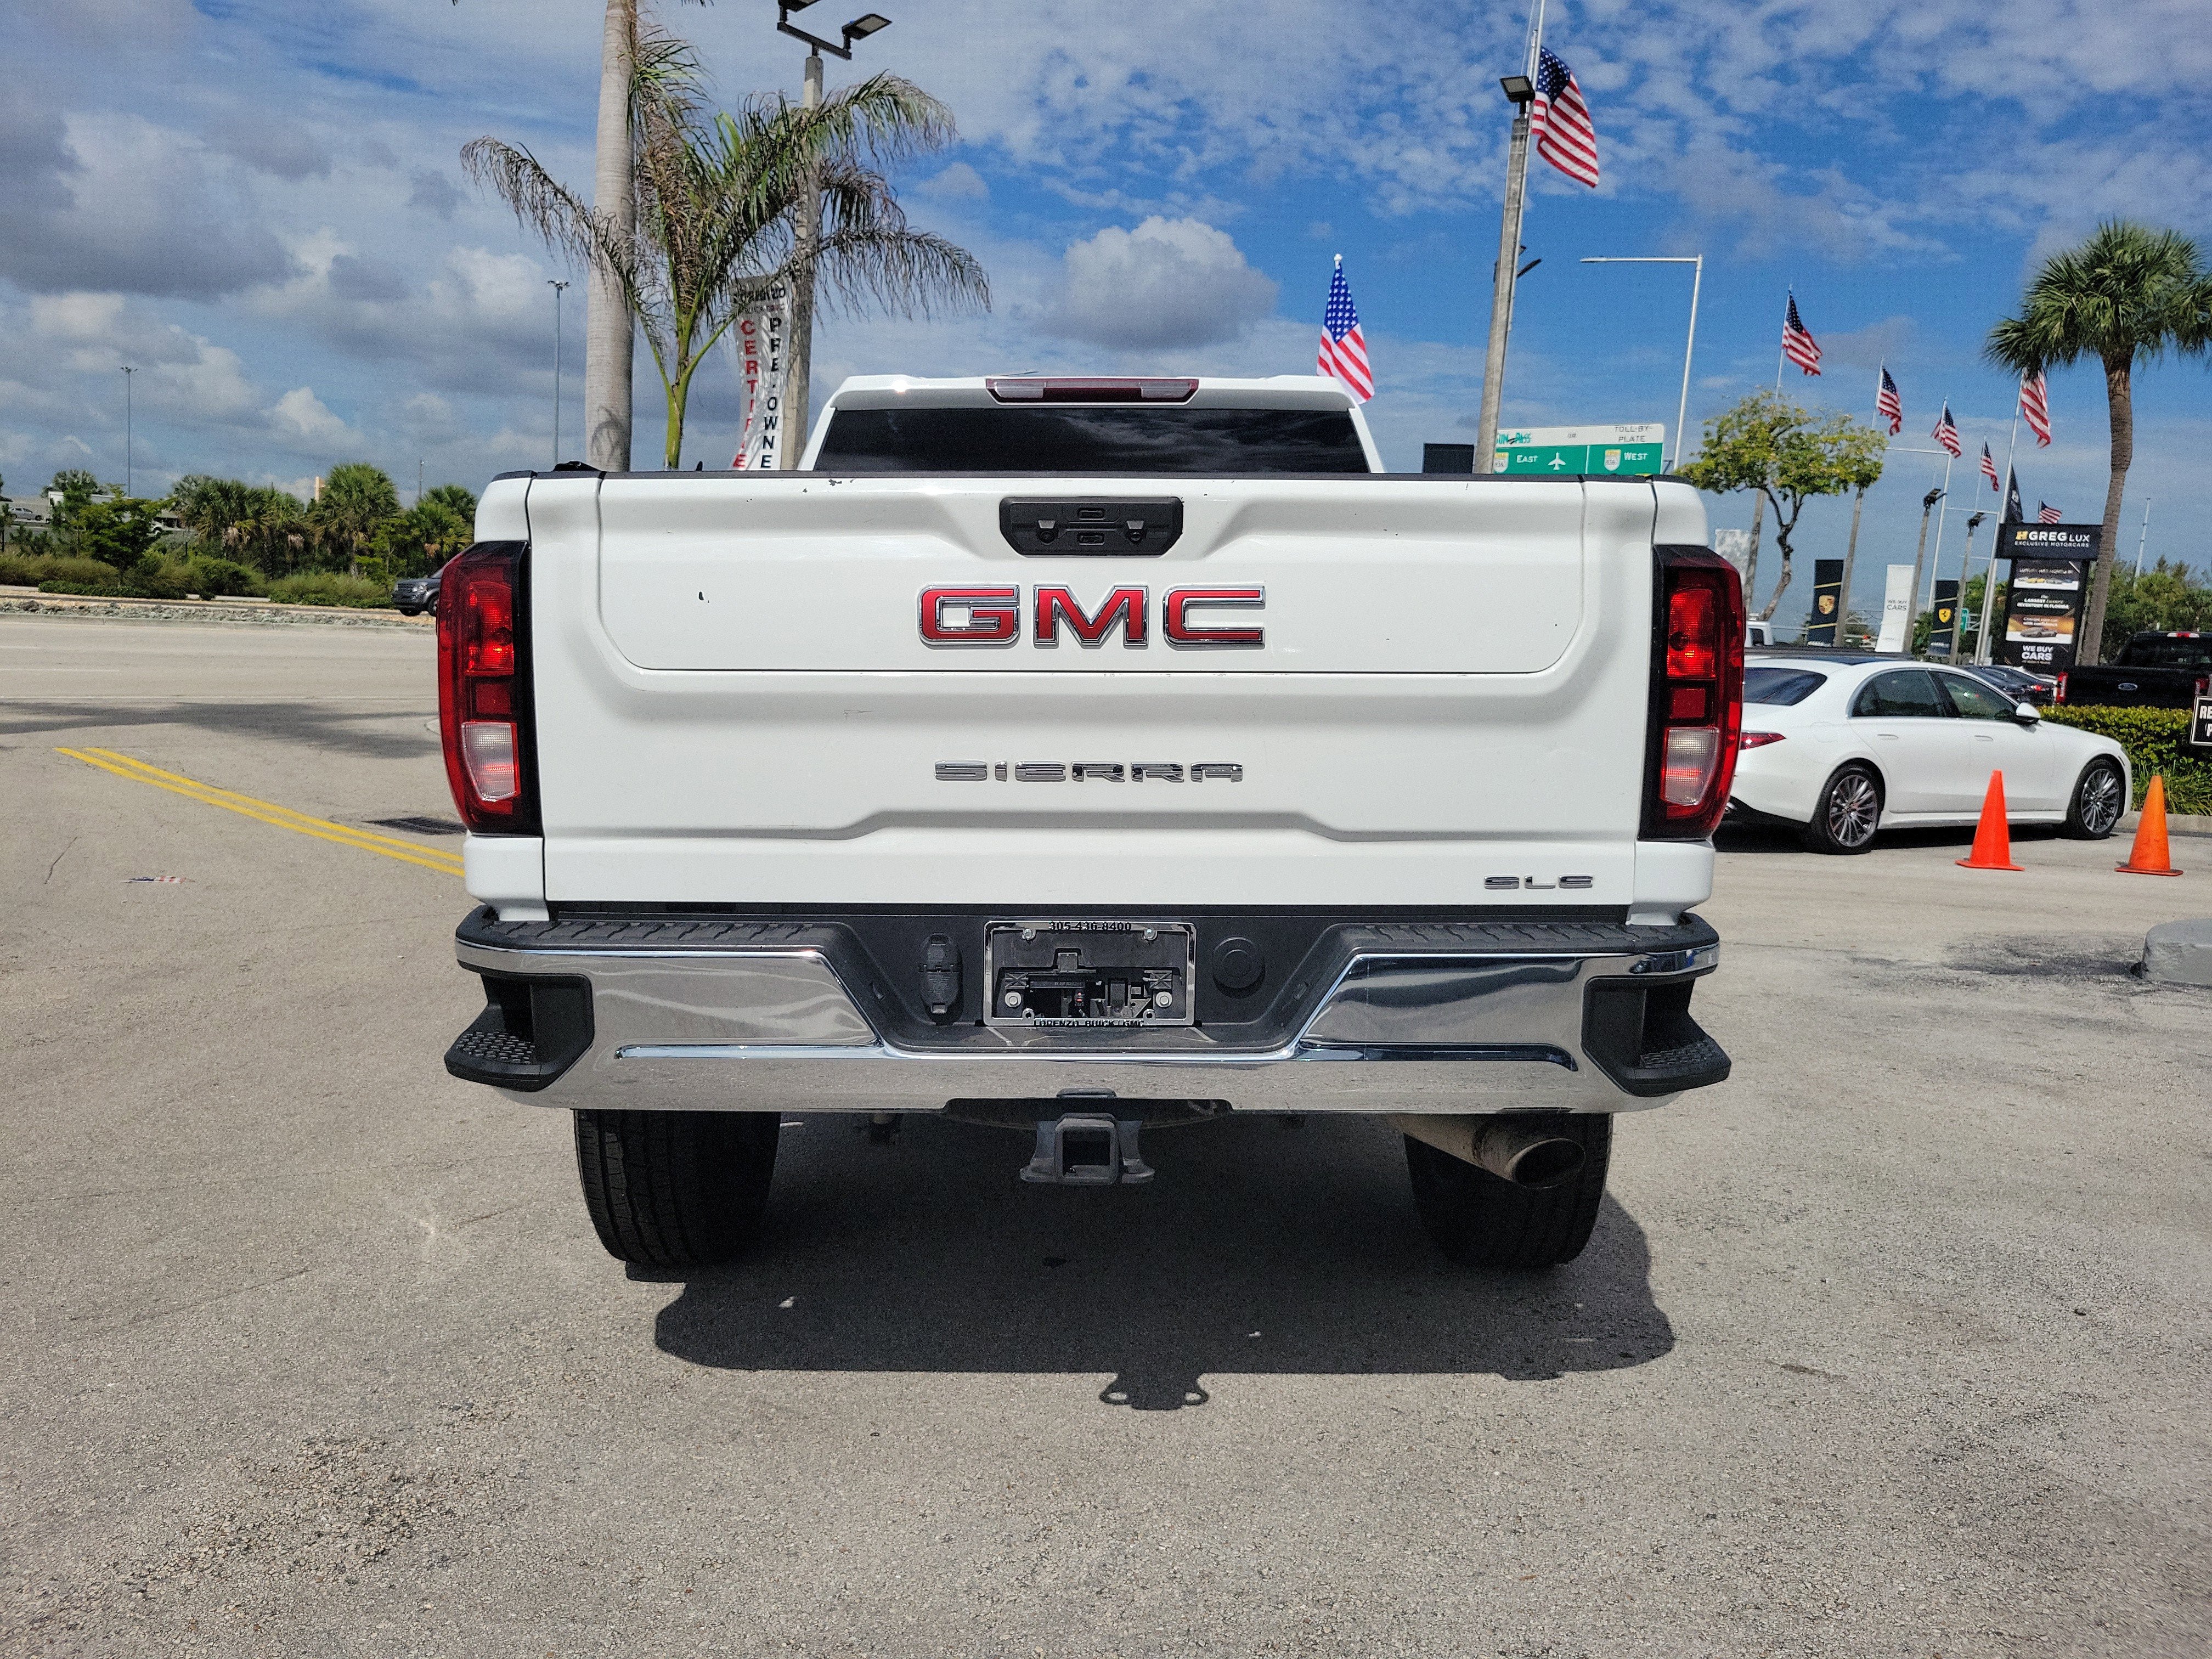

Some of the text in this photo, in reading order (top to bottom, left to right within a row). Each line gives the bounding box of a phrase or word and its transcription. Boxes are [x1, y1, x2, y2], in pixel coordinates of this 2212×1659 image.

[1516, 455, 1538, 463] EAST
[1624, 452, 1647, 460] WEST
[2069, 534, 2090, 543] LUX
[918, 584, 1265, 648] GMC
[2021, 651, 2052, 661] CARS
[934, 760, 1243, 782] SIERRA
[1484, 876, 1593, 889] SLE
[1048, 921, 1132, 931] 305-436-8400
